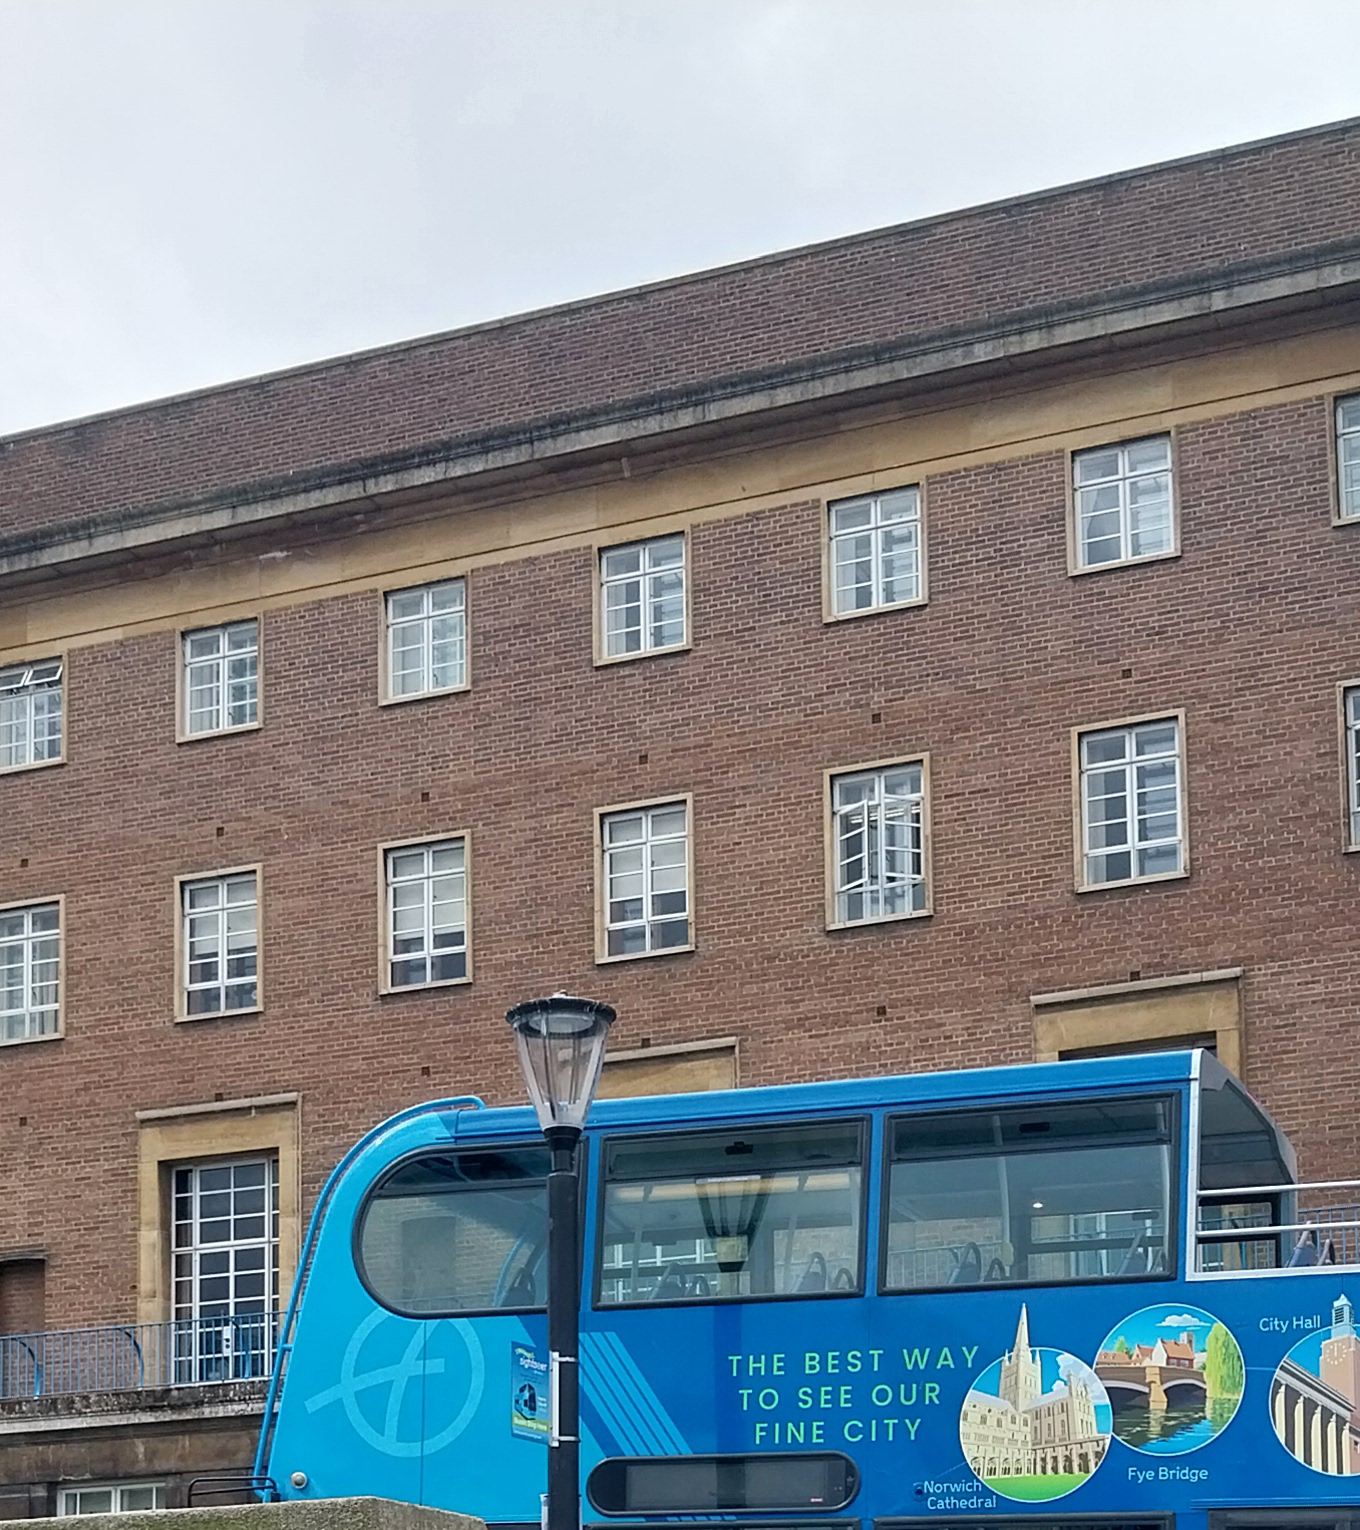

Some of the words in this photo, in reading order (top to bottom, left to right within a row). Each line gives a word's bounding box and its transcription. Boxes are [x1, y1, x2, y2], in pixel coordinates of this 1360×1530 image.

[1259, 1317, 1289, 1333] City
[1292, 1315, 1321, 1329] Hall
[728, 1353, 785, 1377] THE
[804, 1350, 883, 1374] BEST
[902, 1346, 979, 1370] WAY
[739, 1388, 779, 1410] TO
[797, 1386, 853, 1409] SEE
[871, 1382, 941, 1406] OUR
[755, 1421, 825, 1444] FINE
[843, 1418, 921, 1442] CITY
[1128, 1467, 1155, 1483] Fye
[1158, 1466, 1209, 1483] Bridge
[924, 1479, 982, 1494] Norwich
[927, 1494, 997, 1510] Cathedral
